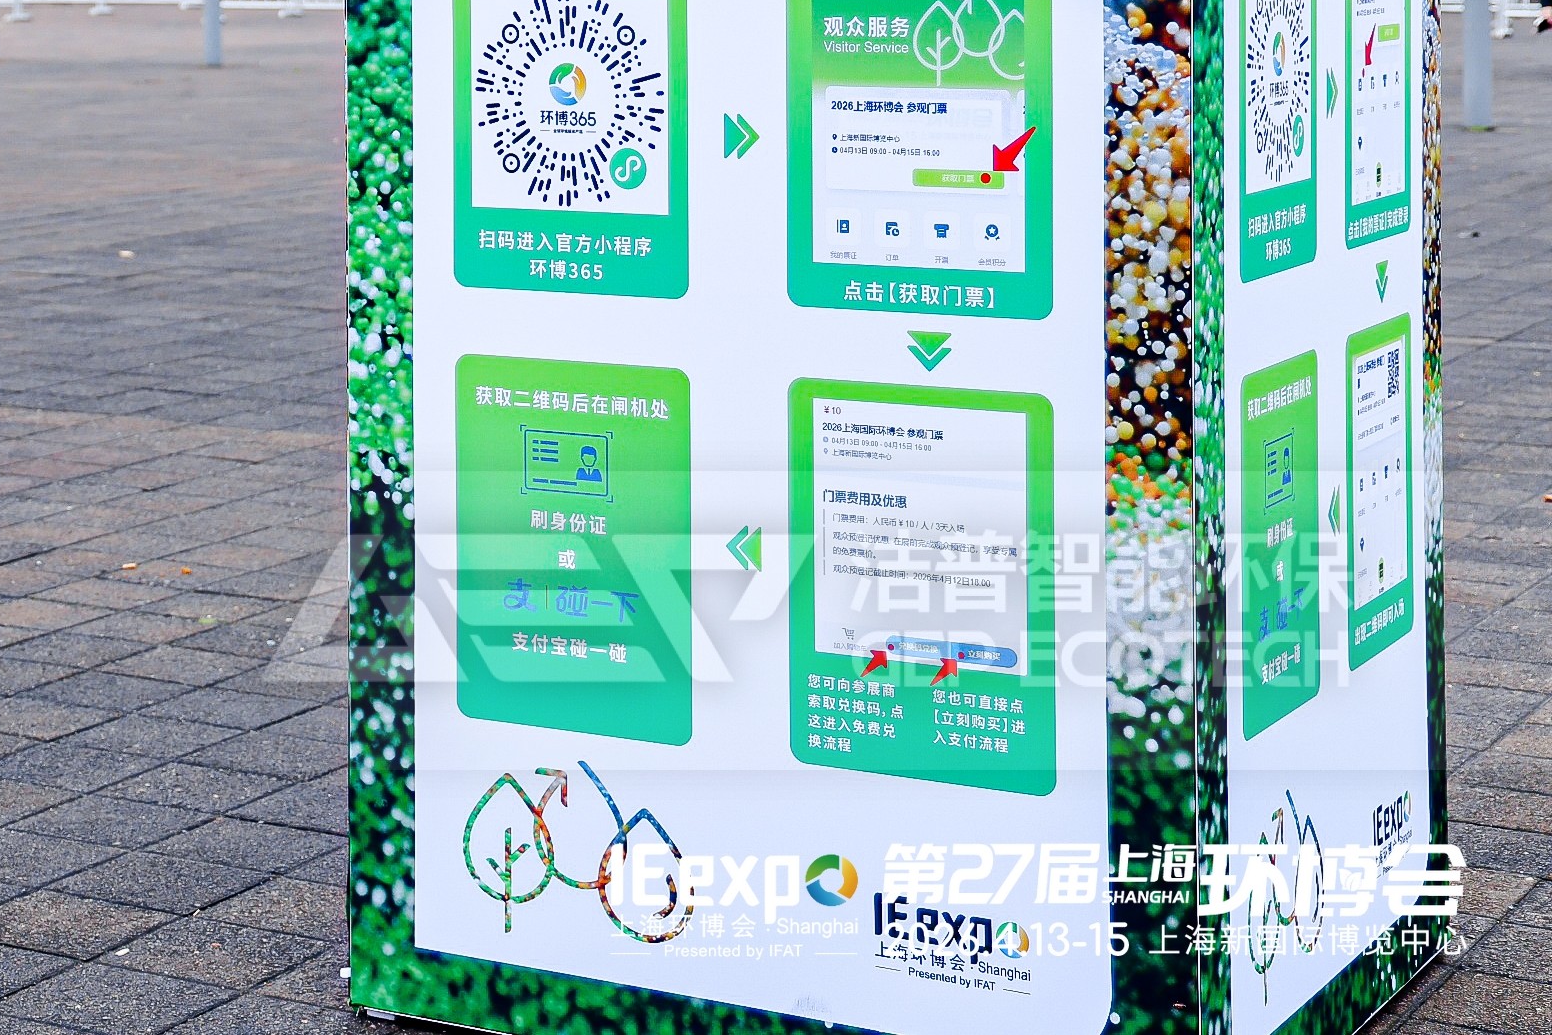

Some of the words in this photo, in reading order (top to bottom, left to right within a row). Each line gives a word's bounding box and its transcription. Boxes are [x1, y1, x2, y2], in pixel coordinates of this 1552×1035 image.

[823, 16, 910, 38] 观众服务
[823, 41, 860, 53] Visitor
[864, 41, 909, 54] Service
[539, 110, 597, 127] 环博365
[831, 100, 904, 114] 2026上海环博会
[906, 101, 948, 114] 参观门票
[1248, 204, 1307, 238] 扫码进入官方小程序
[478, 228, 652, 257] 扫码进入官方小程序
[1265, 237, 1291, 261] 环博365
[529, 259, 604, 281] 环博365
[843, 280, 995, 309] 点击【获取门票】
[475, 386, 670, 420] 获取二维码后在闸机处
[1247, 375, 1312, 422] 获取二维码后在闸机处
[822, 421, 905, 438] 2026上海国际环博会
[907, 427, 944, 441] 参观门票
[823, 489, 907, 509] 门票费用及优惠
[530, 509, 607, 535] 刷身份证
[1266, 517, 1294, 549] 刷身份证
[557, 549, 576, 570] 或
[1275, 561, 1285, 583] 或
[555, 584, 639, 622] 碰一下
[1354, 597, 1405, 646] 出现二维码即可入场
[512, 632, 627, 664] 支付宝碰一碰
[1261, 643, 1301, 686] 支付宝碰一碰
[807, 673, 896, 698] 您可向参展商
[807, 694, 904, 719] 索取兑换码，点
[932, 688, 1024, 714] 您也可直接点
[807, 714, 897, 739] 这进入免费兑
[934, 709, 1026, 735] 【立刻购买】进
[807, 733, 852, 753] 换流程
[933, 730, 1009, 754] 入支付流程
[908, 966, 957, 985] Presented
[959, 976, 971, 989] by
[974, 978, 996, 992] IFAT
[978, 961, 1032, 983] Shanghai
